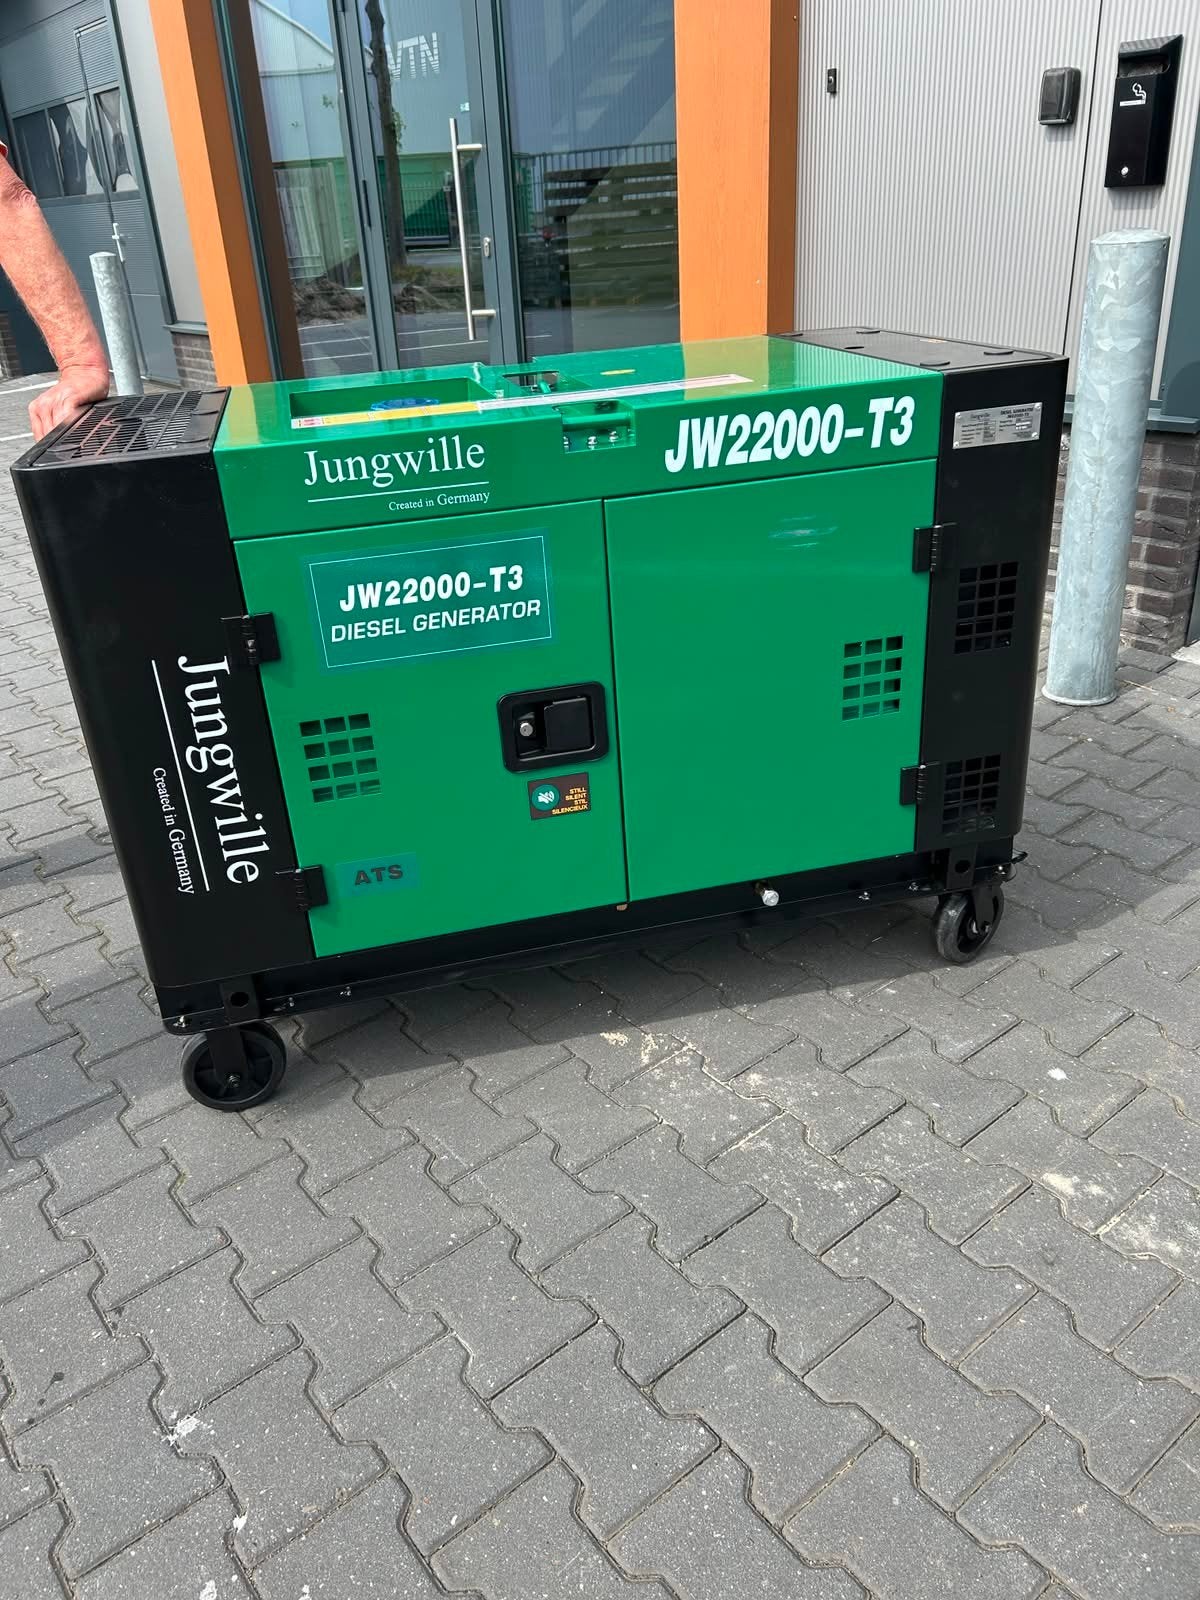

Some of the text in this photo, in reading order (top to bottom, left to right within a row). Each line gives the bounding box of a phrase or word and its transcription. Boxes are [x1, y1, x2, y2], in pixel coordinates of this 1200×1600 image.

[665, 396, 915, 473] JW22000-T3
[304, 435, 485, 488] Jungwille
[388, 492, 490, 511] Created in Germany
[339, 564, 523, 612] JW22000-T3
[331, 599, 541, 642] DIESEL GENERATOR
[178, 656, 270, 884] Jungwille
[153, 767, 195, 894] Created in Germany
[552, 804, 588, 814] SILENCIEUX
[355, 864, 404, 885] ATS
